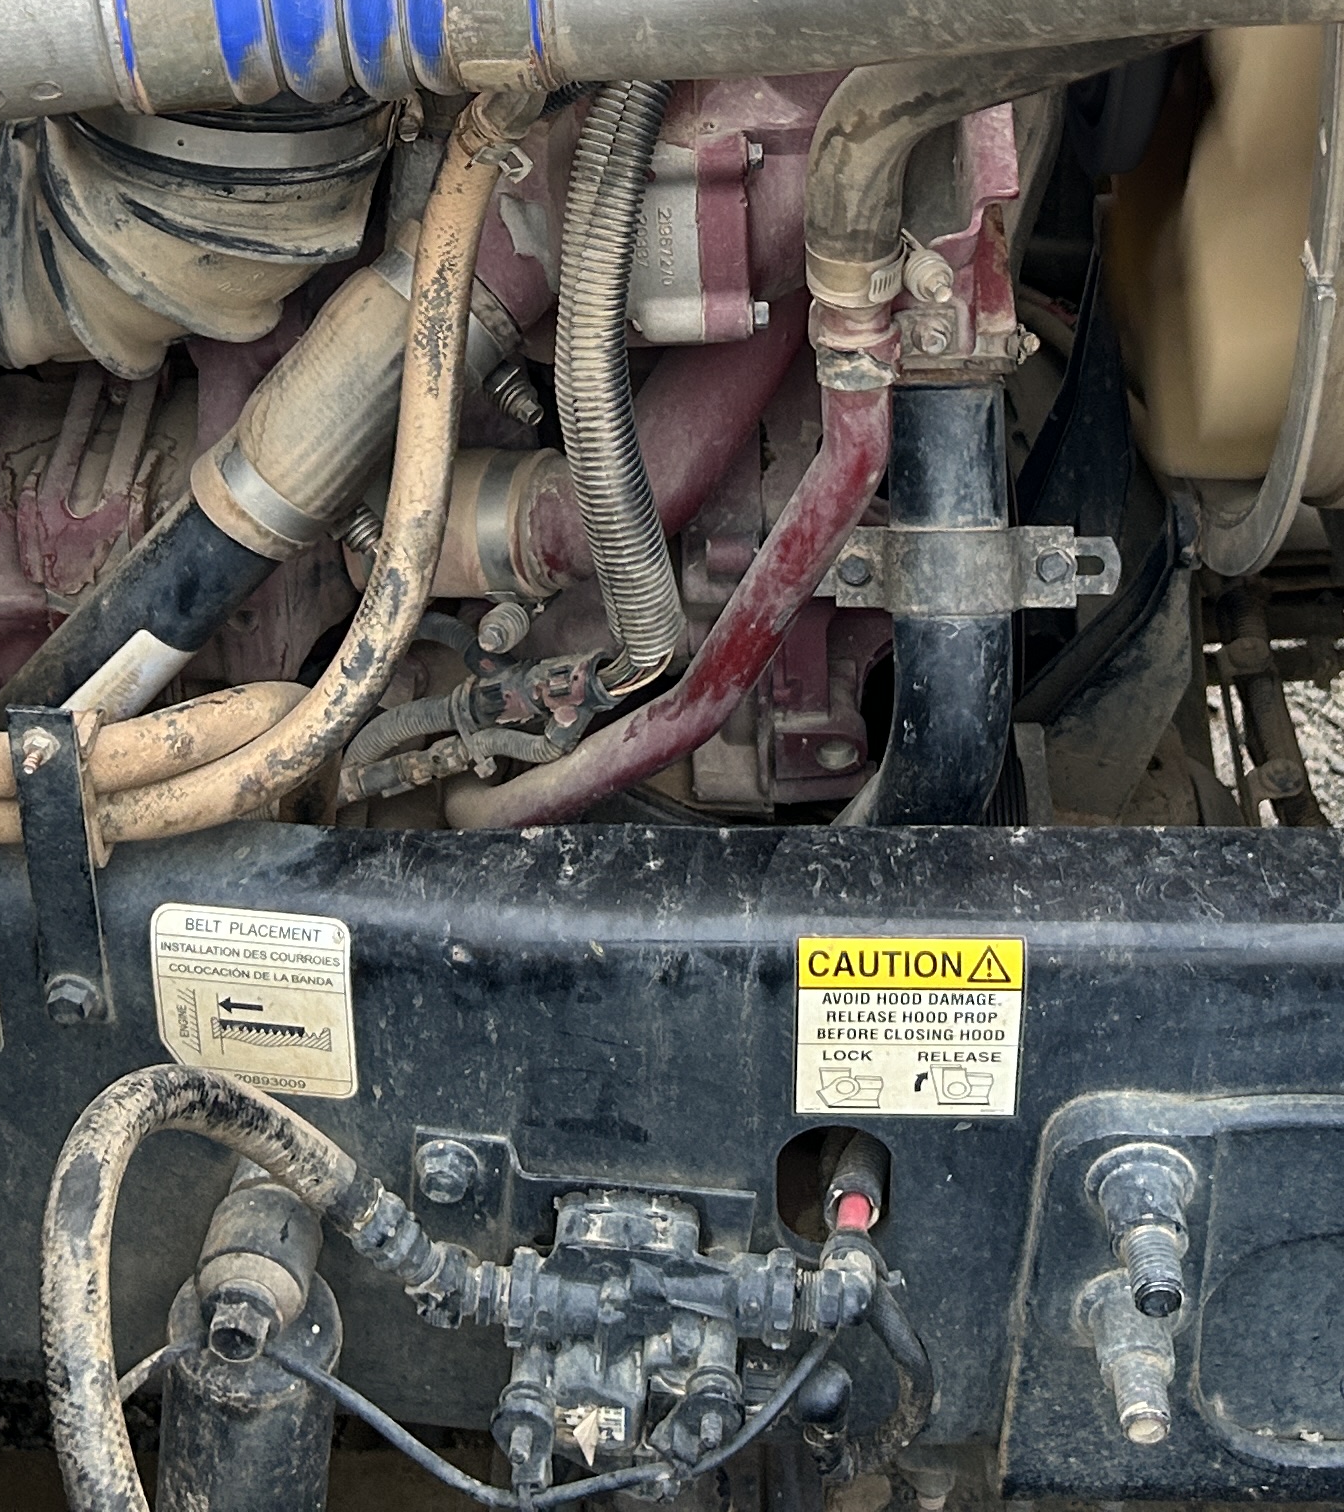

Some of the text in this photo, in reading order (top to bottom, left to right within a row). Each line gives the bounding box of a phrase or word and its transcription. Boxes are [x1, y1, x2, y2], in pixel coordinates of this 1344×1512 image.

[186, 918, 321, 942] BELT PLACEMENT
[161, 942, 340, 966] INSTALLATION DES COURROIES
[808, 950, 962, 978] CAUTION
[169, 963, 333, 986] COLOCACIÓN DE LA BANDA
[822, 992, 1002, 1006] AVOID HOOD DAMAGE.
[178, 1005, 189, 1037] ENGINE
[827, 1011, 997, 1023] RELEASE HOOD PROP
[818, 1029, 1005, 1041] BEFORE CLOSING HOOD
[823, 1050, 872, 1061] LOCK
[918, 1051, 1001, 1062] RELEASE
